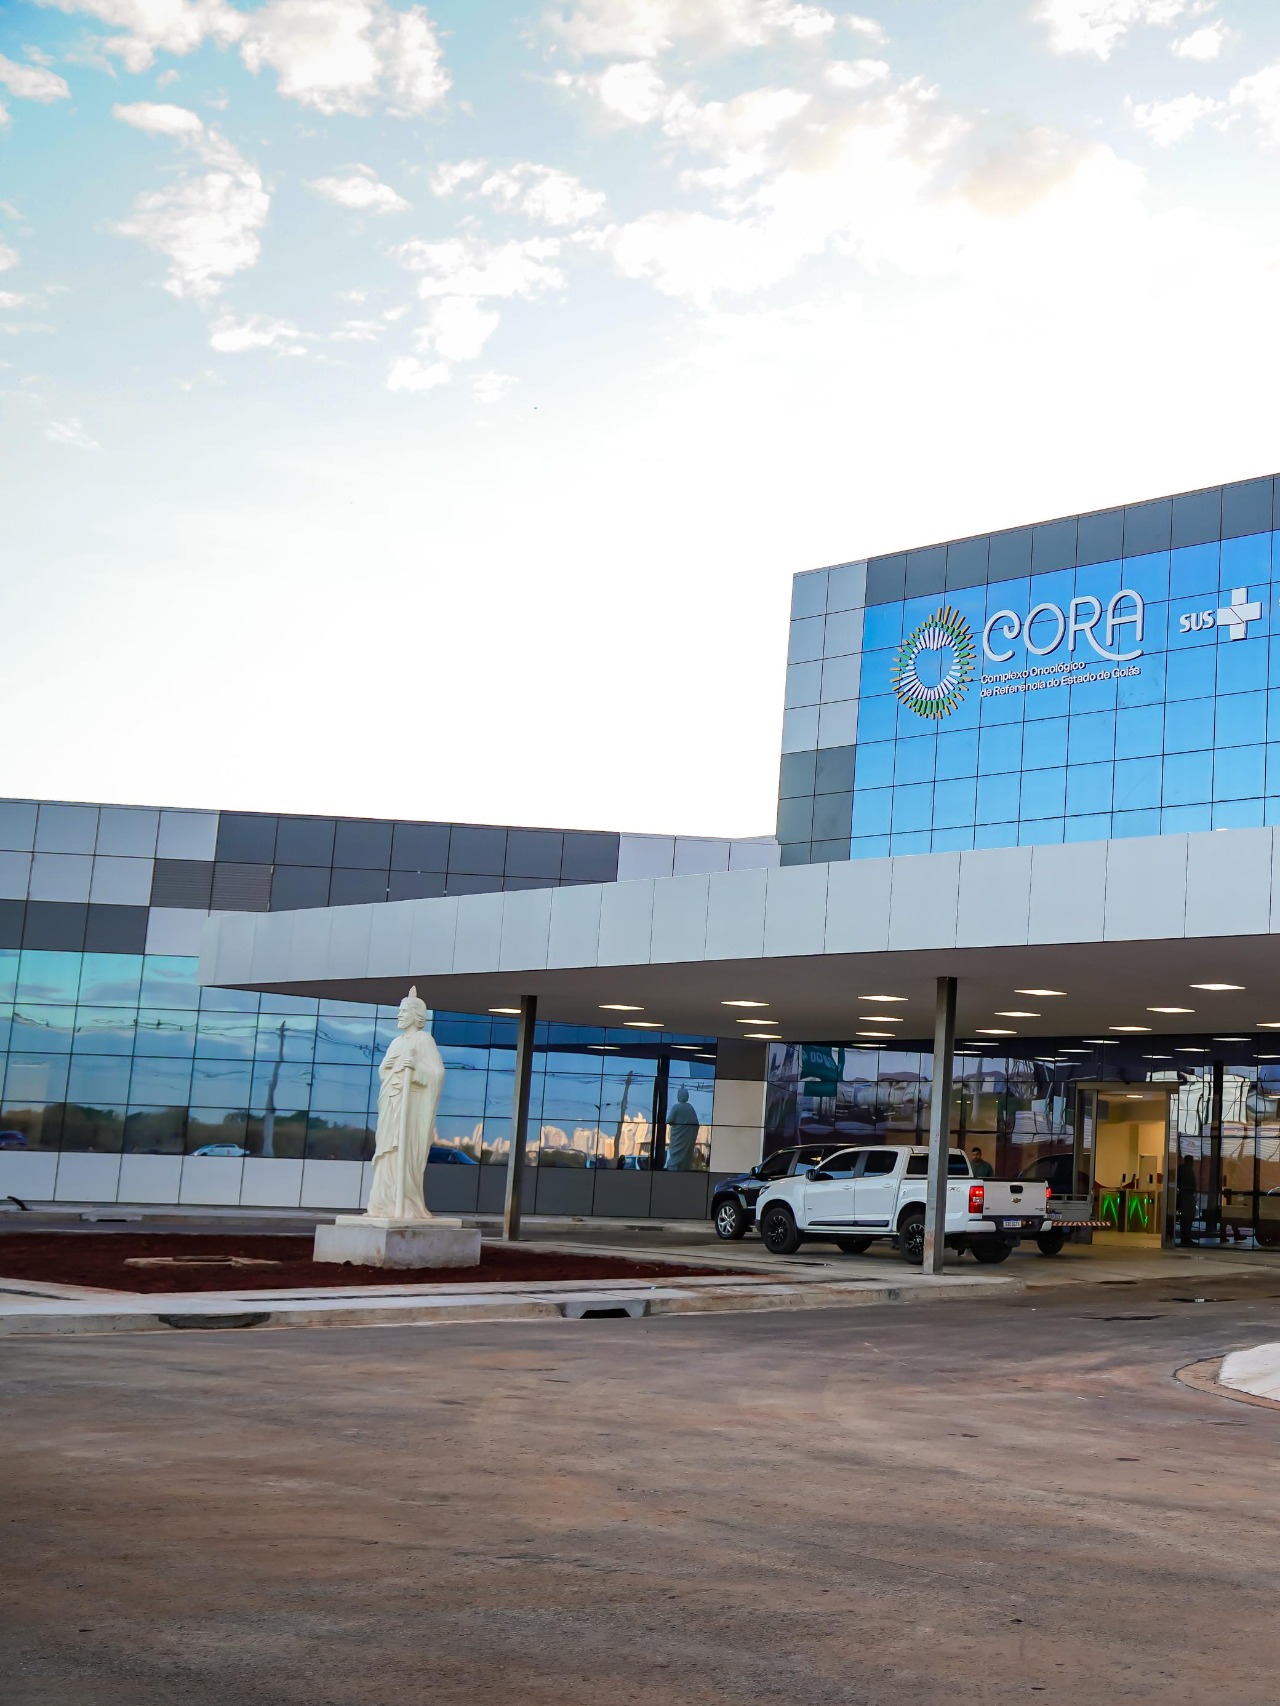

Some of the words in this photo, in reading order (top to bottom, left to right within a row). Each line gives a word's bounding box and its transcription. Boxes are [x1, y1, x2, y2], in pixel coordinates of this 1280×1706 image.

[983, 589, 1144, 661] CORA
[1180, 610, 1215, 633] SUS
[980, 687, 992, 698] de
[993, 681, 1046, 696] Referência
[1048, 676, 1060, 687] do
[1061, 673, 1096, 685] Estado
[1098, 669, 1111, 680] de
[1112, 666, 1140, 677] Goiás
[981, 669, 1029, 685] Complexo
[1031, 661, 1086, 676] Oncológico
